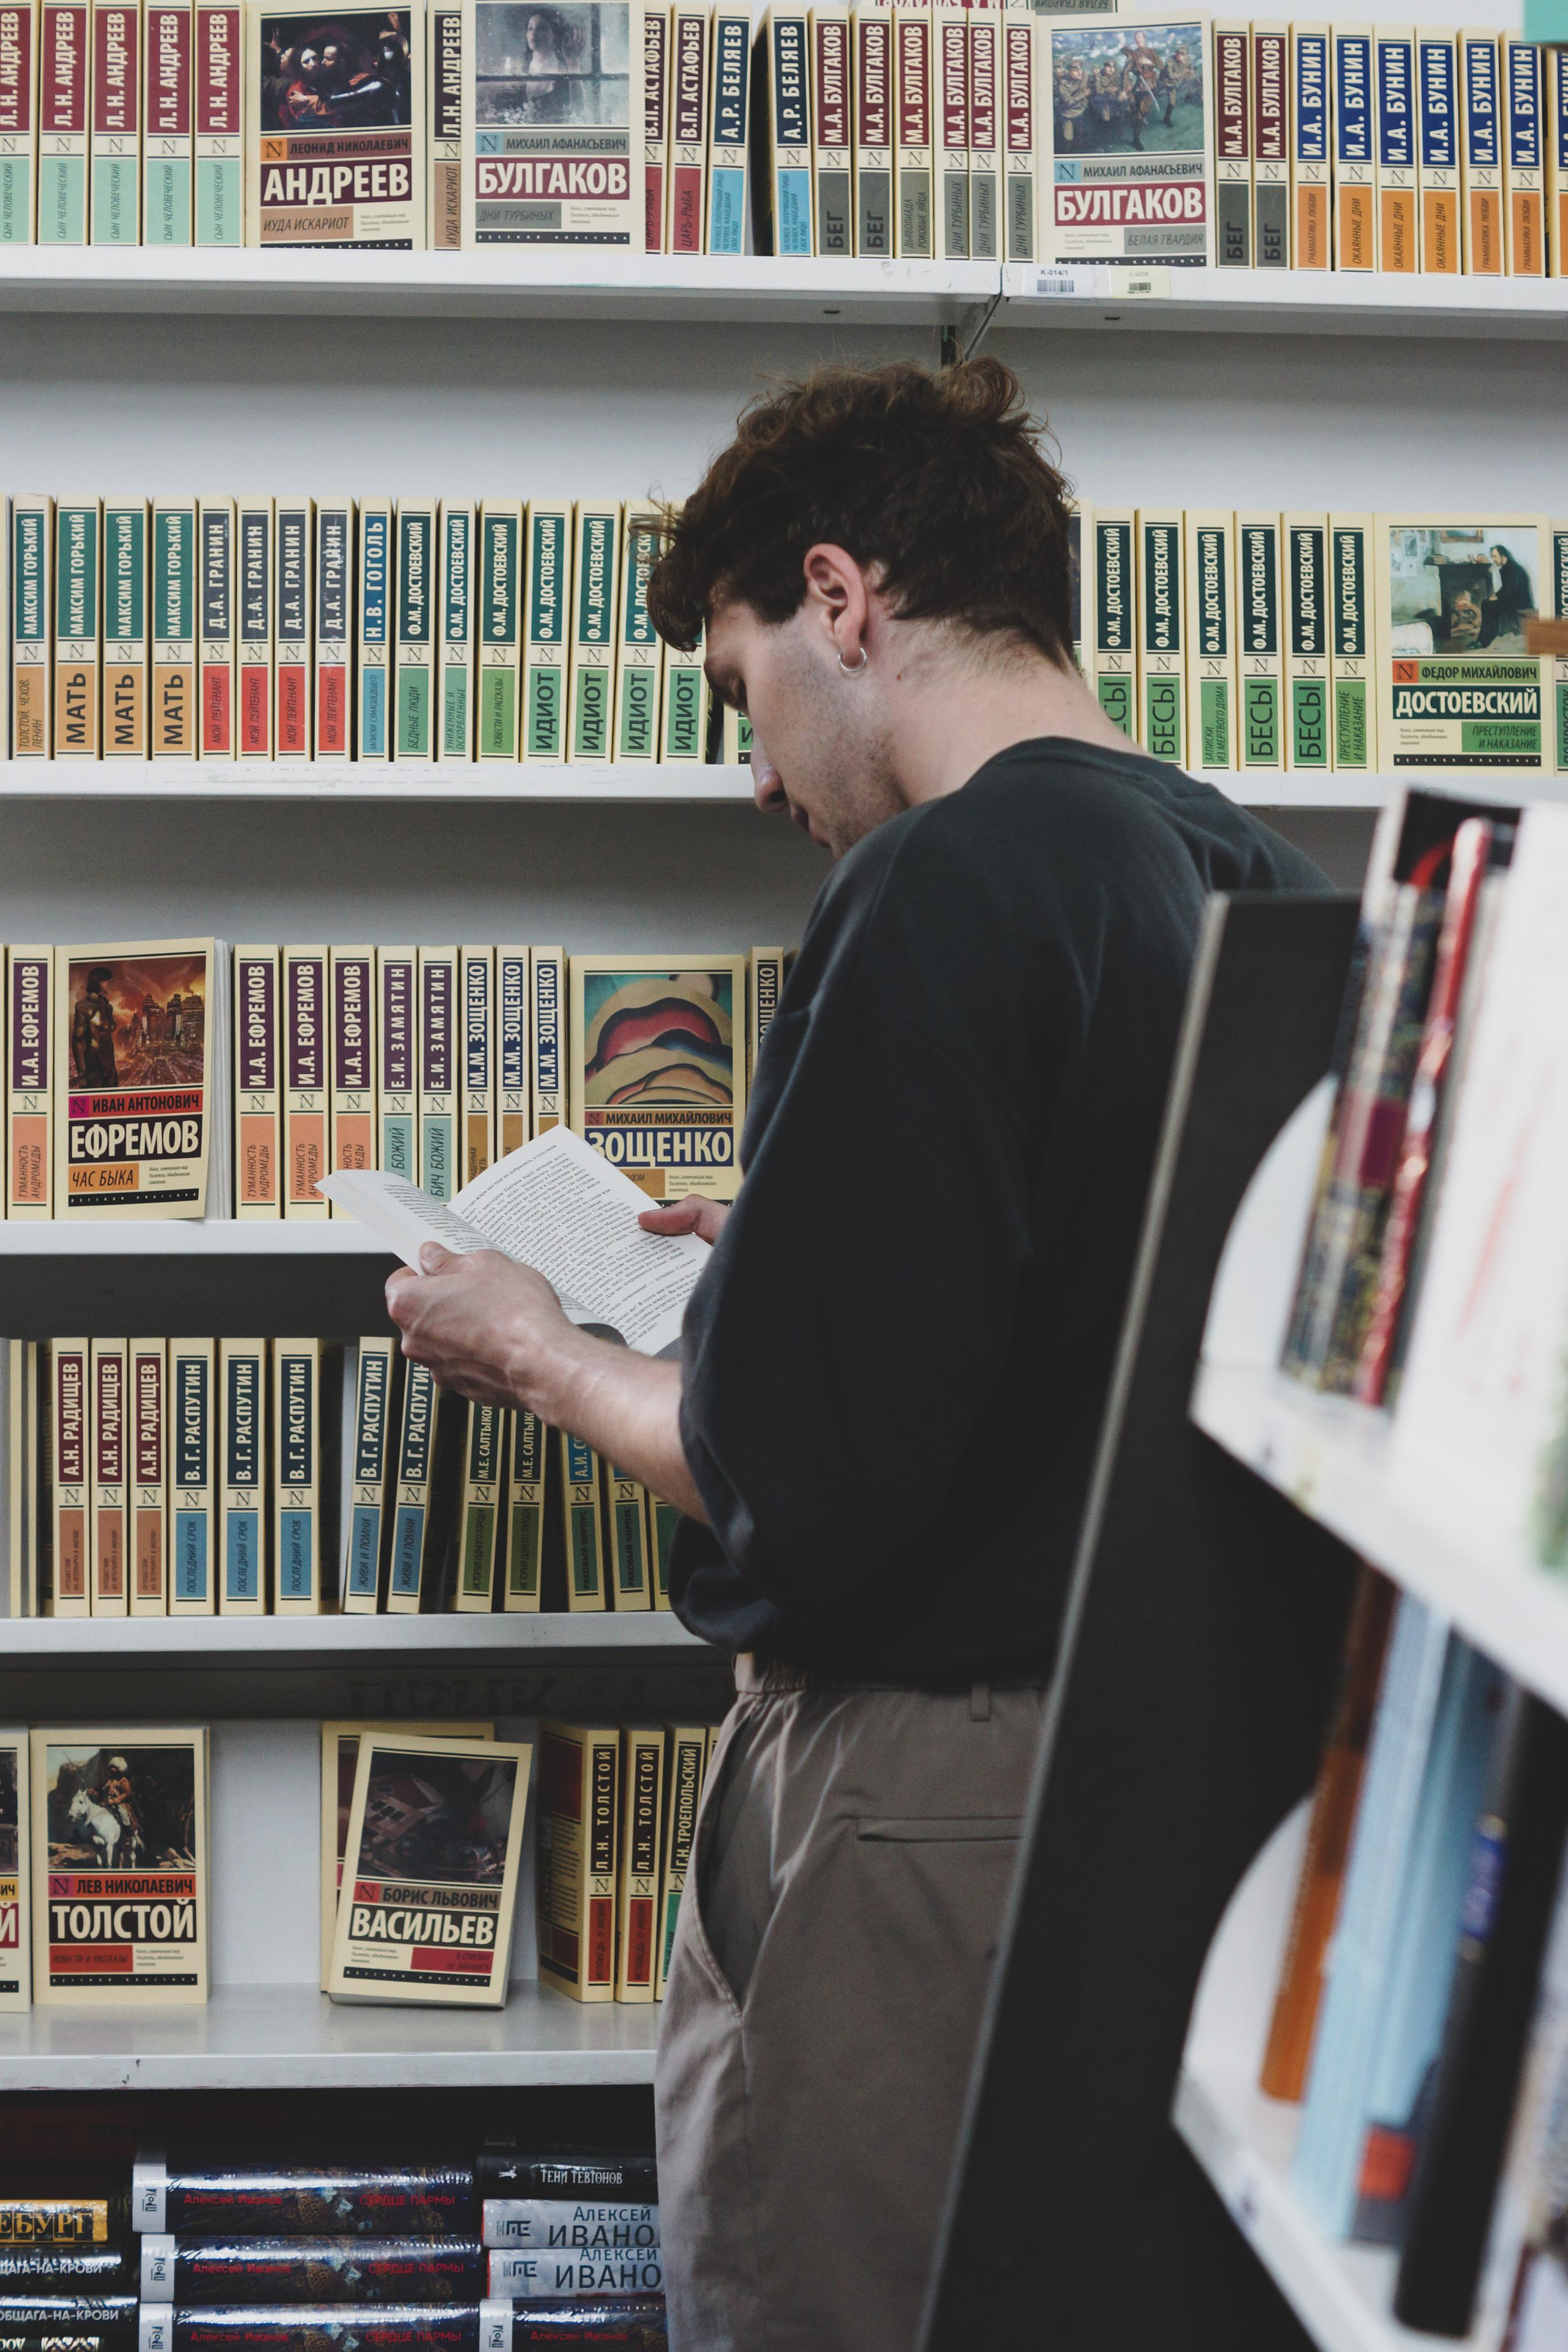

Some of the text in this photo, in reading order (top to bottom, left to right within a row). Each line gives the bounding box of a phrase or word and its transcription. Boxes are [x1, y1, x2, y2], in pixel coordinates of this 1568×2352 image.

[209, 14, 230, 88] АНДРЕЕВ
[443, 17, 461, 95] АНДРЕЕВ
[682, 22, 699, 102] АСТАФЬЕВ
[723, 26, 741, 96] БЕЛЯЕВ
[1011, 31, 1028, 108] БУЛГАКОВ
[1224, 39, 1242, 115] БУЛГАКОВ
[1302, 42, 1321, 107] БУНИН
[1385, 48, 1405, 113] БУНИН
[290, 137, 409, 155] ЛЕОНИД НИКОЛАЕВИЧ
[506, 138, 627, 151] МИХАИЛ АФАНАСЬЕВИЧ
[1084, 163, 1203, 178] МИХАИЛ АФАНАСЬЕВИЧ
[162, 164, 173, 241] СЫН ЧЕЛОВЕЧЕСКИЙ
[263, 163, 409, 205] АНДРЕЕВ
[446, 165, 460, 245] ИУДА ИСКАРИОТ
[478, 162, 628, 195] БУЛГАКОВ
[1057, 187, 1204, 221] БУЛГАКОВ
[263, 219, 292, 233] ИУДА
[294, 217, 350, 231] ИСКАРИОТ
[478, 209, 501, 222] ДНИ
[504, 209, 555, 222] ТУРБИНЫХ
[682, 189, 693, 247] ЦАРЬ-РЫБА
[1016, 183, 1029, 255] ДНИ ТУРБИНЫХ
[1128, 233, 1204, 246] БЕЛАЯ ГВАРДИЯ
[1227, 221, 1243, 259] БЕГ
[1308, 220, 1317, 264] ГРАММАТИКА
[1393, 202, 1404, 268] ОКАЯННЫЕ ДНИ
[21, 519, 37, 634] МАКСИМ ГОРЬКИЙ
[69, 514, 85, 634] МАКСИМ ГОРЬКИЙ
[285, 526, 300, 587] ГРАНИН
[367, 522, 383, 590] ГОГОЛЬ
[407, 522, 424, 605] ДОСТОЕВСКИЙ
[450, 519, 466, 605] ДОСТОЕВСКИЙ
[540, 520, 556, 606] ДОСТОЕВСКИЙ
[1202, 534, 1221, 620] ДОСТОЕВСКИЙ
[1249, 532, 1268, 618] ДОСТОЕВСКИЙ
[1340, 535, 1359, 621] ДОСТОЕВСКИЙ
[1396, 687, 1537, 717] ДОСТОЕВСКИЙ
[1422, 665, 1537, 680] ФЕДОР МИХАЙЛОВИЧ
[18, 709, 30, 748] ТОЛСТОЙ.
[31, 719, 42, 748] ЛЕНИН
[66, 673, 86, 744] МАТЬ
[285, 677, 297, 744] МОЙ ЛЕЙТЕНАНТ
[408, 686, 420, 748] БЕДНЫЕ ЛЮДИ
[445, 700, 455, 749] УНИЖЕННЫЕ
[456, 687, 466, 750] ОСКОРБЛЕННЫЕ
[535, 673, 556, 749] ИДИОТ
[1216, 685, 1226, 762] ИЗ МЕРТВОГО ДОМА
[1250, 685, 1273, 756] БЕСЫ
[1339, 690, 1350, 761] ПРЕСТУПЛЕНИЕ
[1353, 696, 1363, 751] НАКАЗАНИЕ
[1472, 725, 1537, 737] ПРЕСТУПЛЕНИЕ
[1205, 726, 1214, 761] ЗАПИСКИ
[1479, 738, 1537, 749] И НАКАЗАНИЕ
[21, 966, 39, 1047] ЕФРЕМОВ
[431, 970, 444, 1051] ЗАМЯТИН
[505, 965, 522, 1041] ЗОЩЕНКО
[92, 1094, 200, 1114] ИВАН АНТОНОВИЧ
[606, 1111, 731, 1125] МИХАИЛ МИХАЙЛОВИЧ
[71, 1120, 199, 1159] ЕФРЕМОВ
[428, 1128, 444, 1197] БИЧ БОЖИЙ
[589, 1131, 731, 1167] ЗОЩЕНКО
[18, 1145, 28, 1198] ТУМАННОСТЬ
[31, 1145, 40, 1199] АНДРОМЕДЫ
[72, 1170, 96, 1188] ЧАС
[99, 1169, 134, 1186] БЫКА
[63, 1363, 81, 1440] РАДИЩЕВ
[290, 1364, 304, 1442] РАСПУТИН
[292, 1520, 302, 1592] ПОСЛЕДНИЙ СРОК
[597, 1752, 610, 1825] ТОЛСТОЙ
[678, 1749, 696, 1842] ТРОЕПОЛЬСКИЙ
[77, 1879, 192, 1893] ЛЕВ НИКОЛАЕВИЧ
[382, 1888, 498, 1909] БОРИС ЛЬВОВИЧ
[52, 1898, 194, 1939] ТОЛСТОЙ
[351, 1908, 494, 1945] ВАСИЛЬЕВ
[411, 2195, 456, 2205] ПАРМЫ
[541, 2168, 623, 2185] ТЕНИ ТЕВТОНОВ
[549, 2225, 655, 2247] ИВАНО
[417, 2331, 462, 2342] ПАРМЫ
